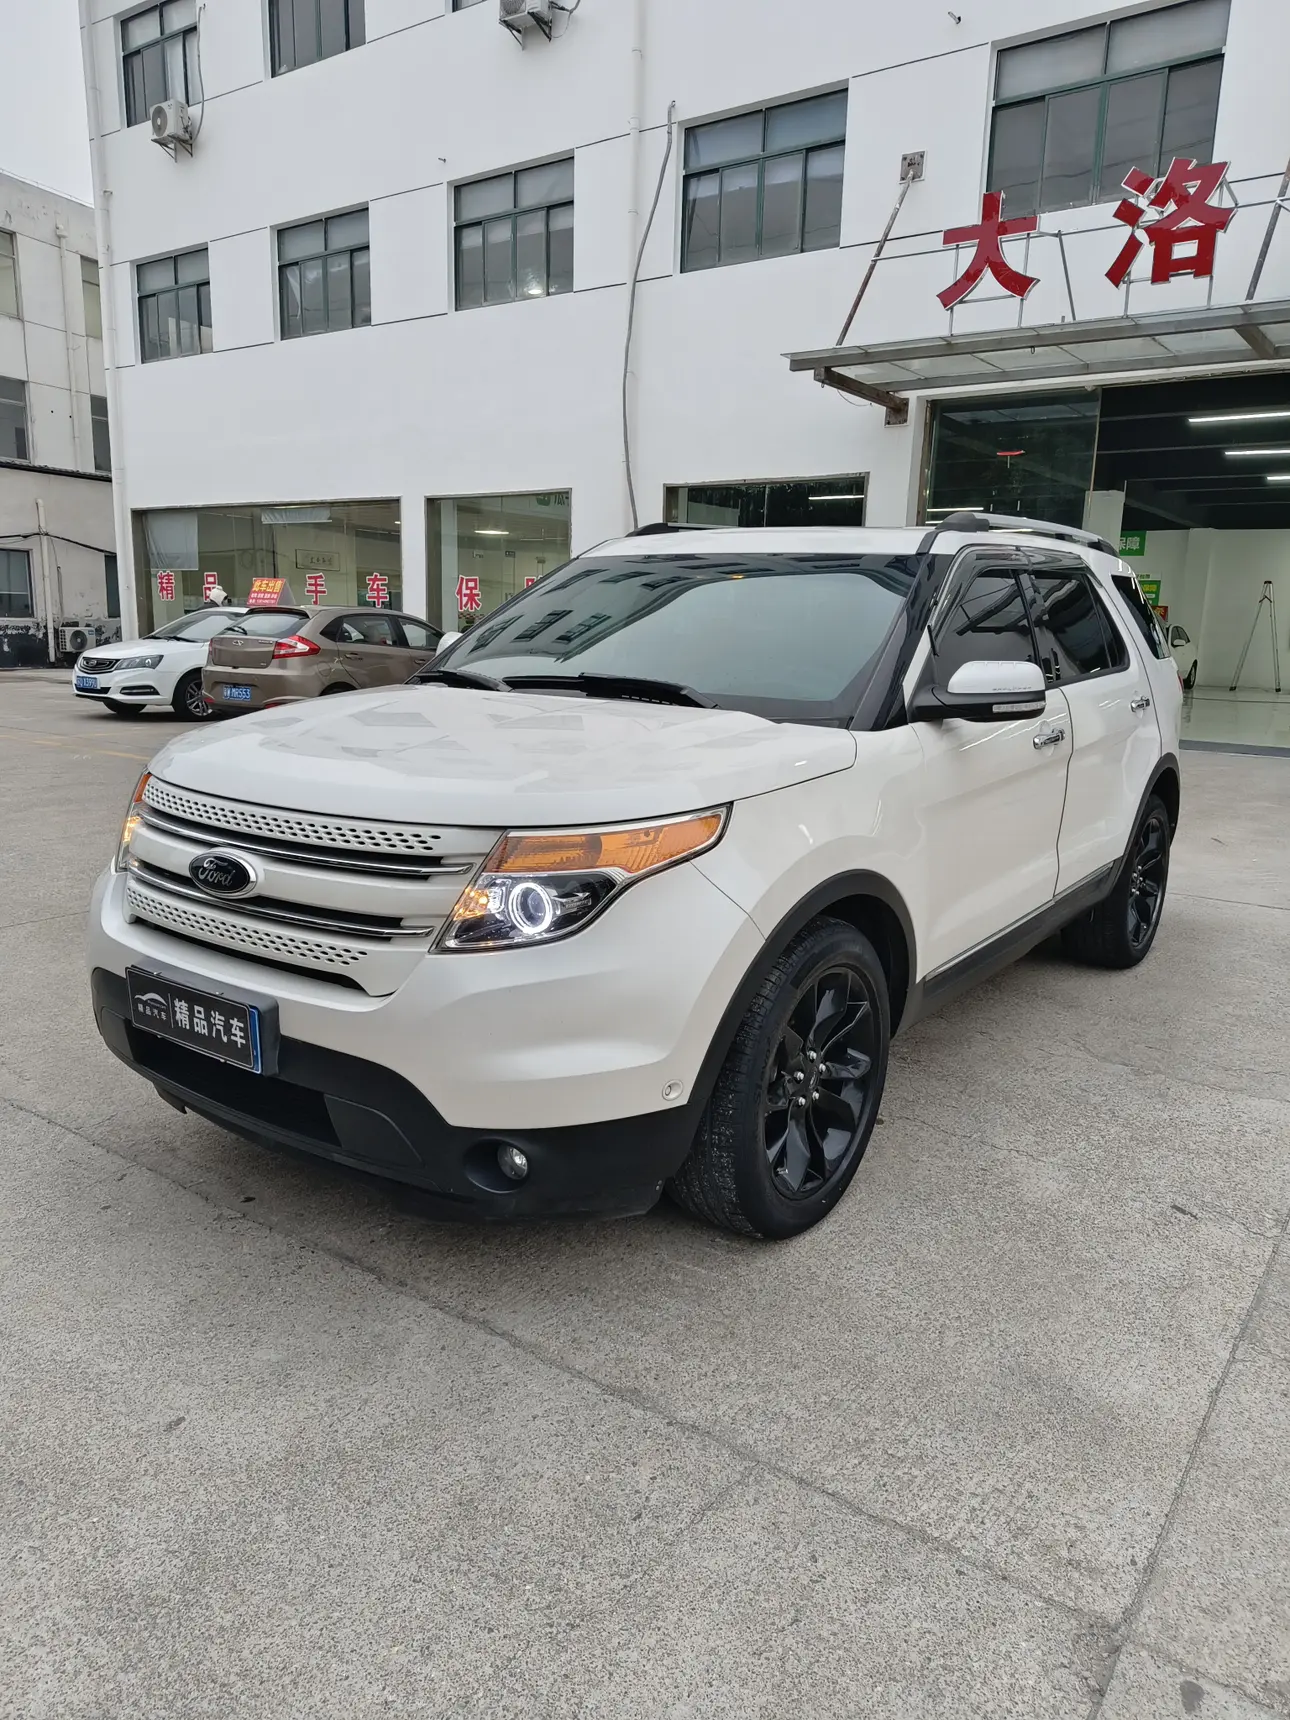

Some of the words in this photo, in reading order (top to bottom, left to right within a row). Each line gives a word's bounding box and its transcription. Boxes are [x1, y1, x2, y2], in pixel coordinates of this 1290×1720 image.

[936, 156, 1238, 311] 大洛
[198, 856, 236, 887] Ford
[173, 998, 246, 1048] 精品汽车
